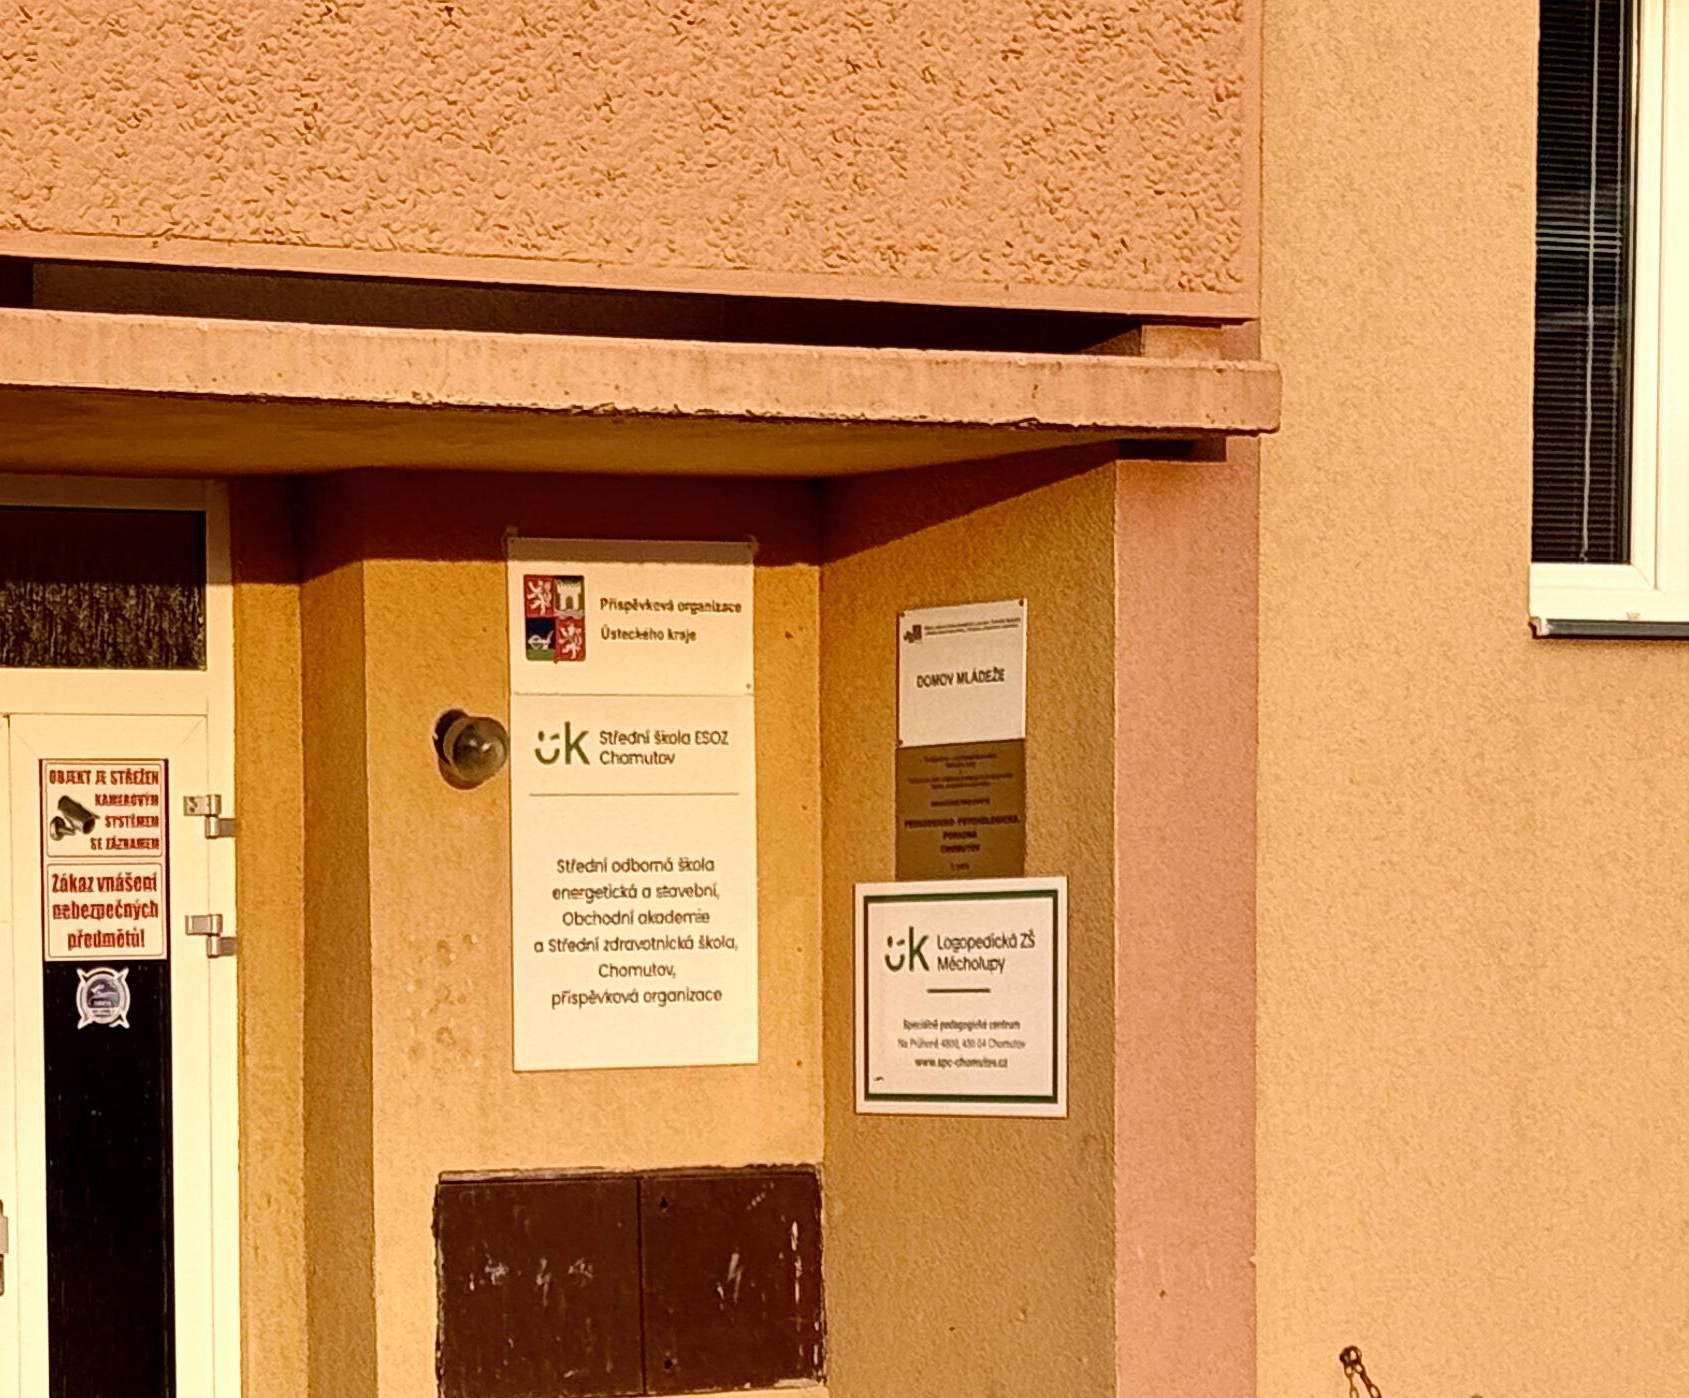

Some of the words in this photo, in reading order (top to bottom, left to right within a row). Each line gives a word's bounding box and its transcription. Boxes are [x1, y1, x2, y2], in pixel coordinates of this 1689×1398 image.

[600, 597, 675, 614] Příspěvková
[678, 599, 742, 615] organizace
[601, 624, 664, 641] Ústeckého
[668, 627, 696, 644] kraje
[916, 671, 954, 689] DOMOV
[956, 667, 1006, 684] MLÁDEŽE
[599, 729, 650, 745] Střední
[654, 729, 691, 745] škola
[695, 730, 729, 745] ESOZ
[599, 750, 675, 766] Chomutov
[49, 769, 92, 786] OBJEKT
[96, 769, 107, 785] JE
[110, 768, 159, 786] STŘEŽEN
[94, 791, 159, 807] KAMEROVÝM
[104, 813, 159, 828] SYSTÉMEM
[90, 837, 102, 850] SE
[105, 836, 159, 850] ZÁZNAMEM
[556, 857, 607, 874] Střední
[612, 857, 674, 873] odborná
[678, 856, 715, 873] škola
[52, 873, 95, 894] Zákaz
[97, 872, 157, 893] vnášení
[552, 884, 637, 904] energetická
[641, 887, 651, 899] a
[656, 882, 720, 900] stavební,
[52, 900, 158, 921] nebezpečných
[562, 910, 634, 927] Obchodní
[638, 908, 710, 925] akademie
[67, 927, 145, 950] předmětů!
[534, 940, 543, 953] a
[549, 936, 599, 953] Střední
[603, 935, 694, 953] zdravotnická
[698, 935, 738, 952] škola,
[937, 932, 1017, 953] Logopedická
[1019, 929, 1035, 949] ZŠ
[598, 962, 676, 979] Chomutov,
[937, 955, 1006, 975] Měcholupy
[551, 990, 639, 1009] příspěvková
[644, 986, 722, 1007] organizace
